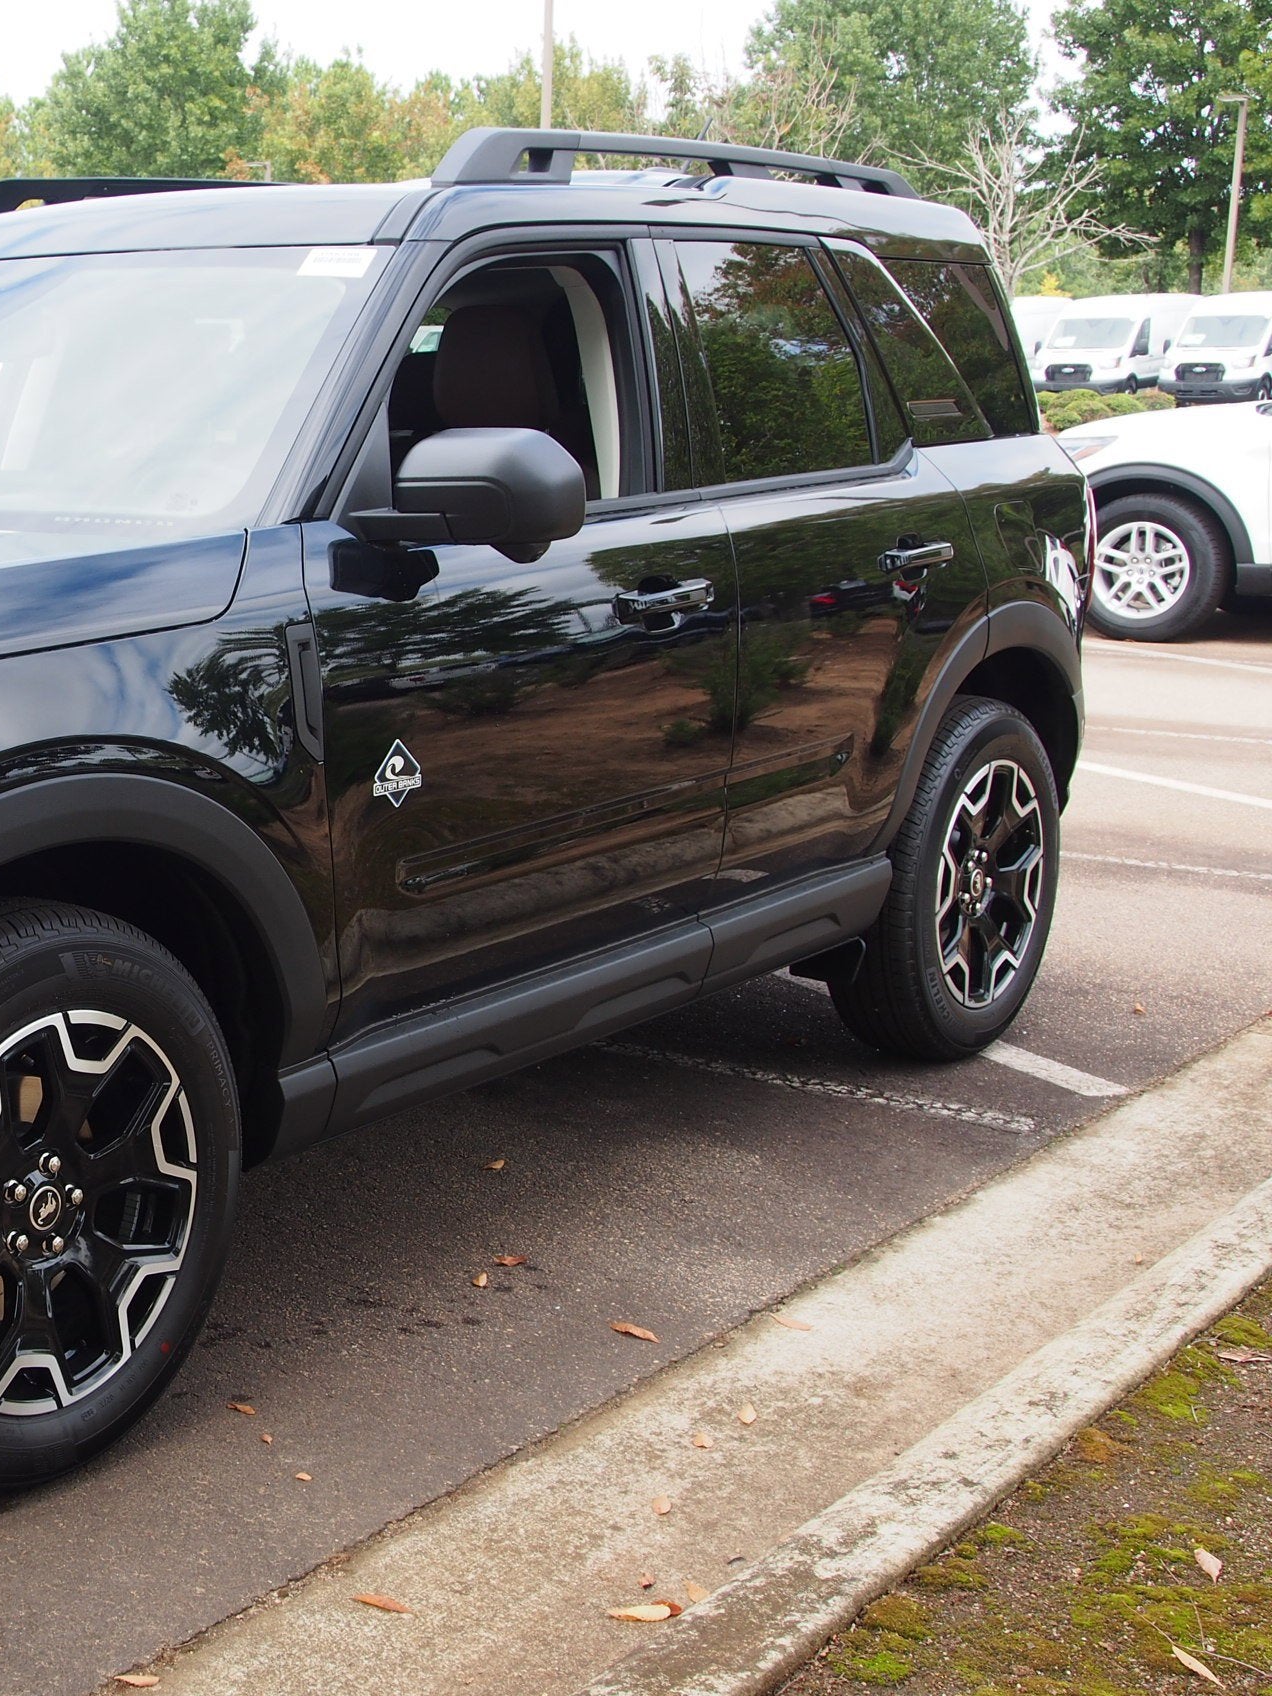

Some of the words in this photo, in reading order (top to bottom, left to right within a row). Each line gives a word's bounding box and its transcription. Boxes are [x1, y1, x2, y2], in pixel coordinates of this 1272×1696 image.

[376, 782, 397, 793] OUTER
[398, 777, 420, 788] BANKS
[206, 1040, 232, 1109] PRIMACY
